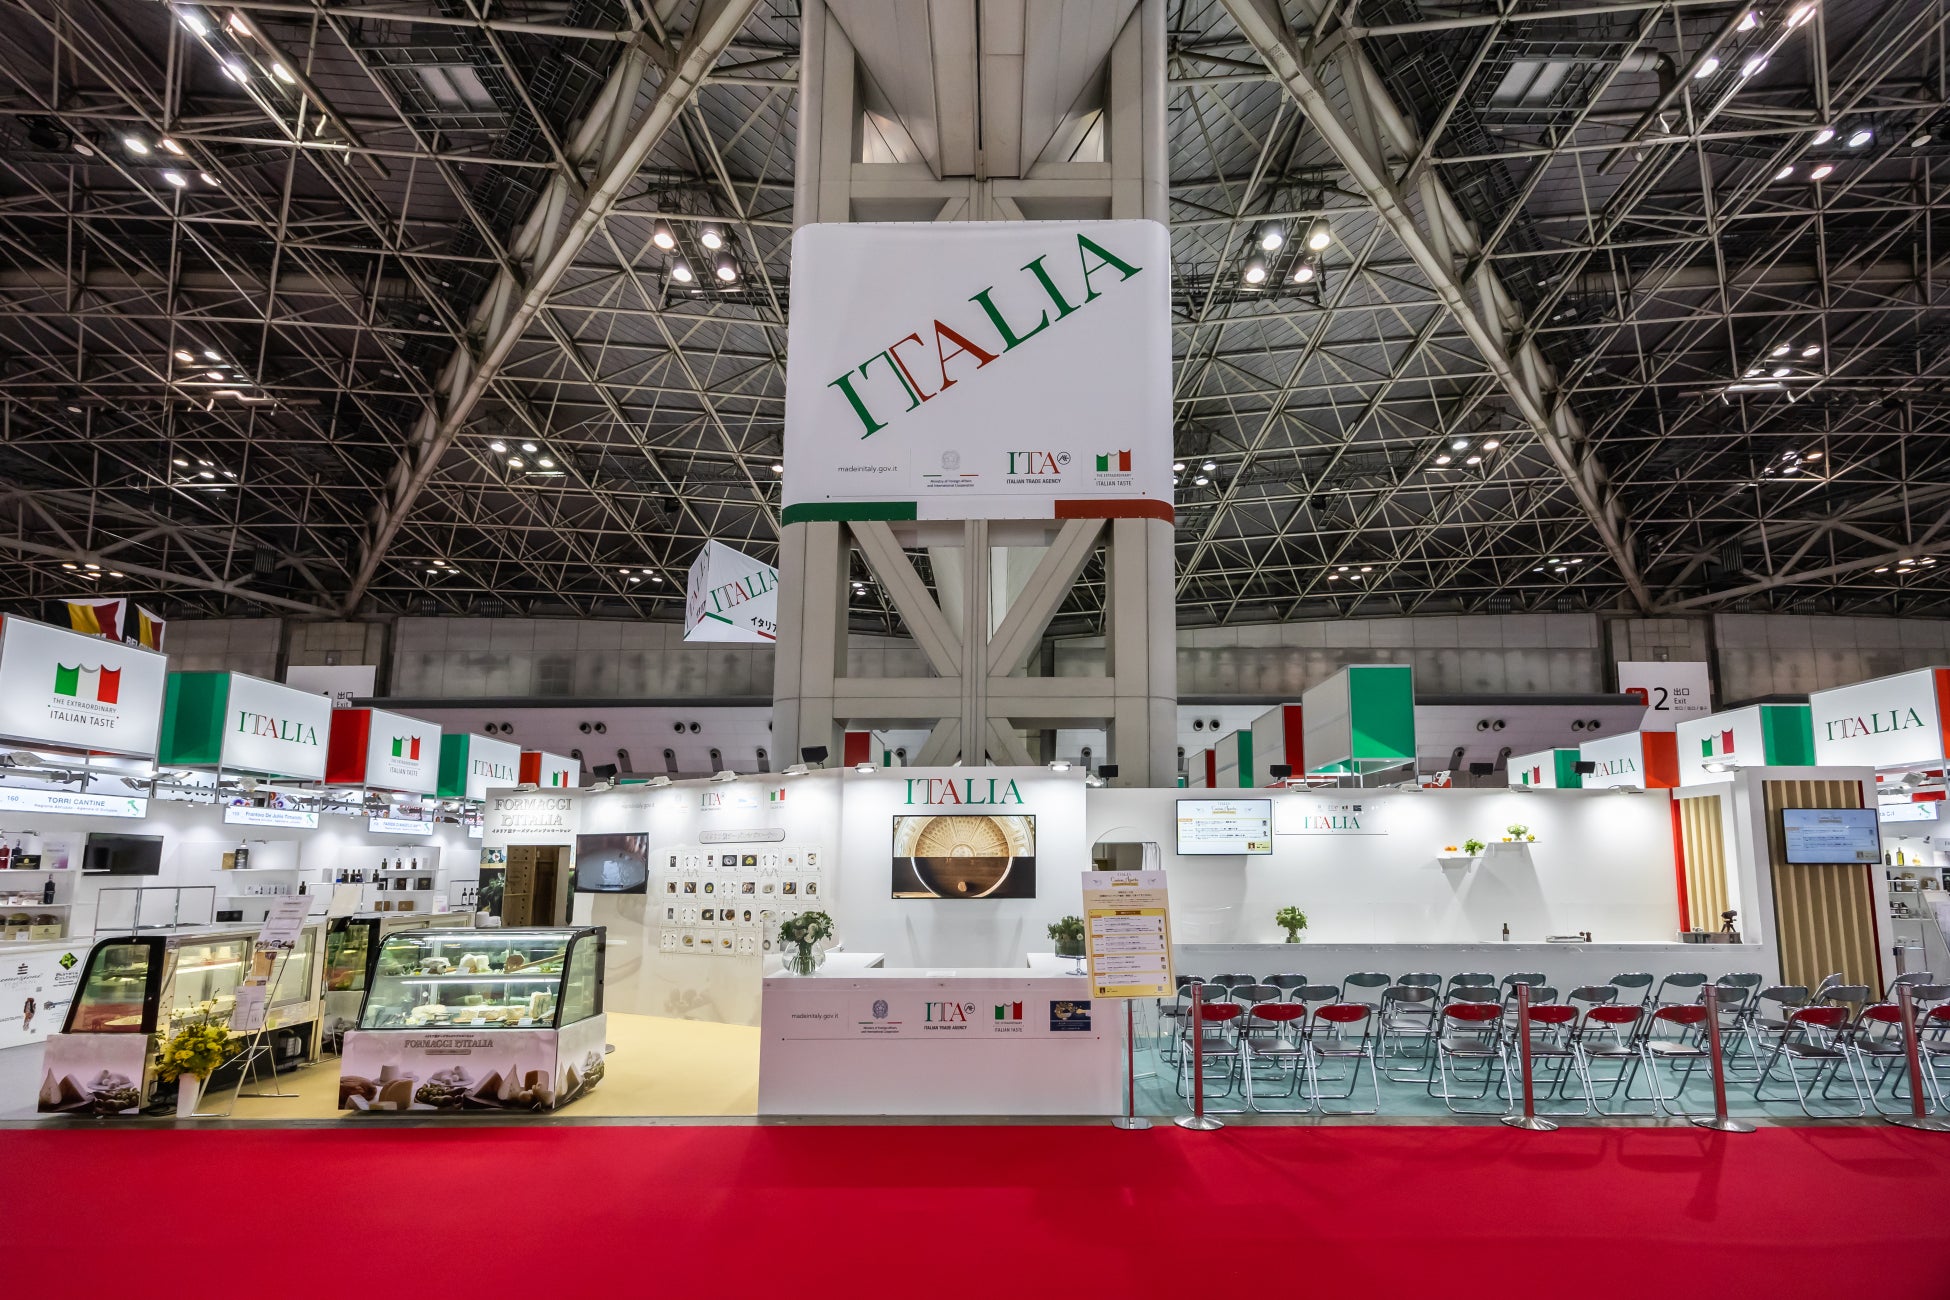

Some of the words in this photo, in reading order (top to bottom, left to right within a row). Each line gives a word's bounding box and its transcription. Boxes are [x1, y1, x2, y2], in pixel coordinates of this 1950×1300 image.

[827, 233, 1143, 440] ITALIA
[837, 465, 898, 474] madeinitaly.gov.it
[1006, 451, 1060, 474] ITA
[709, 568, 779, 613] ITALIA
[1653, 687, 1670, 711] 2
[1673, 688, 1690, 696] 出口
[53, 697, 65, 705] THE
[66, 699, 117, 713] EXTRAORDINARY
[50, 710, 86, 724] ITALIAN
[90, 716, 115, 729] TASTE
[237, 710, 318, 746] ITALIA
[1825, 707, 1925, 742] ITALIA
[473, 759, 513, 781] ITALIA
[48, 796, 72, 805] TORRI
[73, 798, 105, 807] CANTINE
[904, 778, 1025, 805] ITALIA
[1304, 815, 1361, 829] ITALIA
[924, 1002, 967, 1022] ITA
[404, 1039, 453, 1048] FORMAGGI
